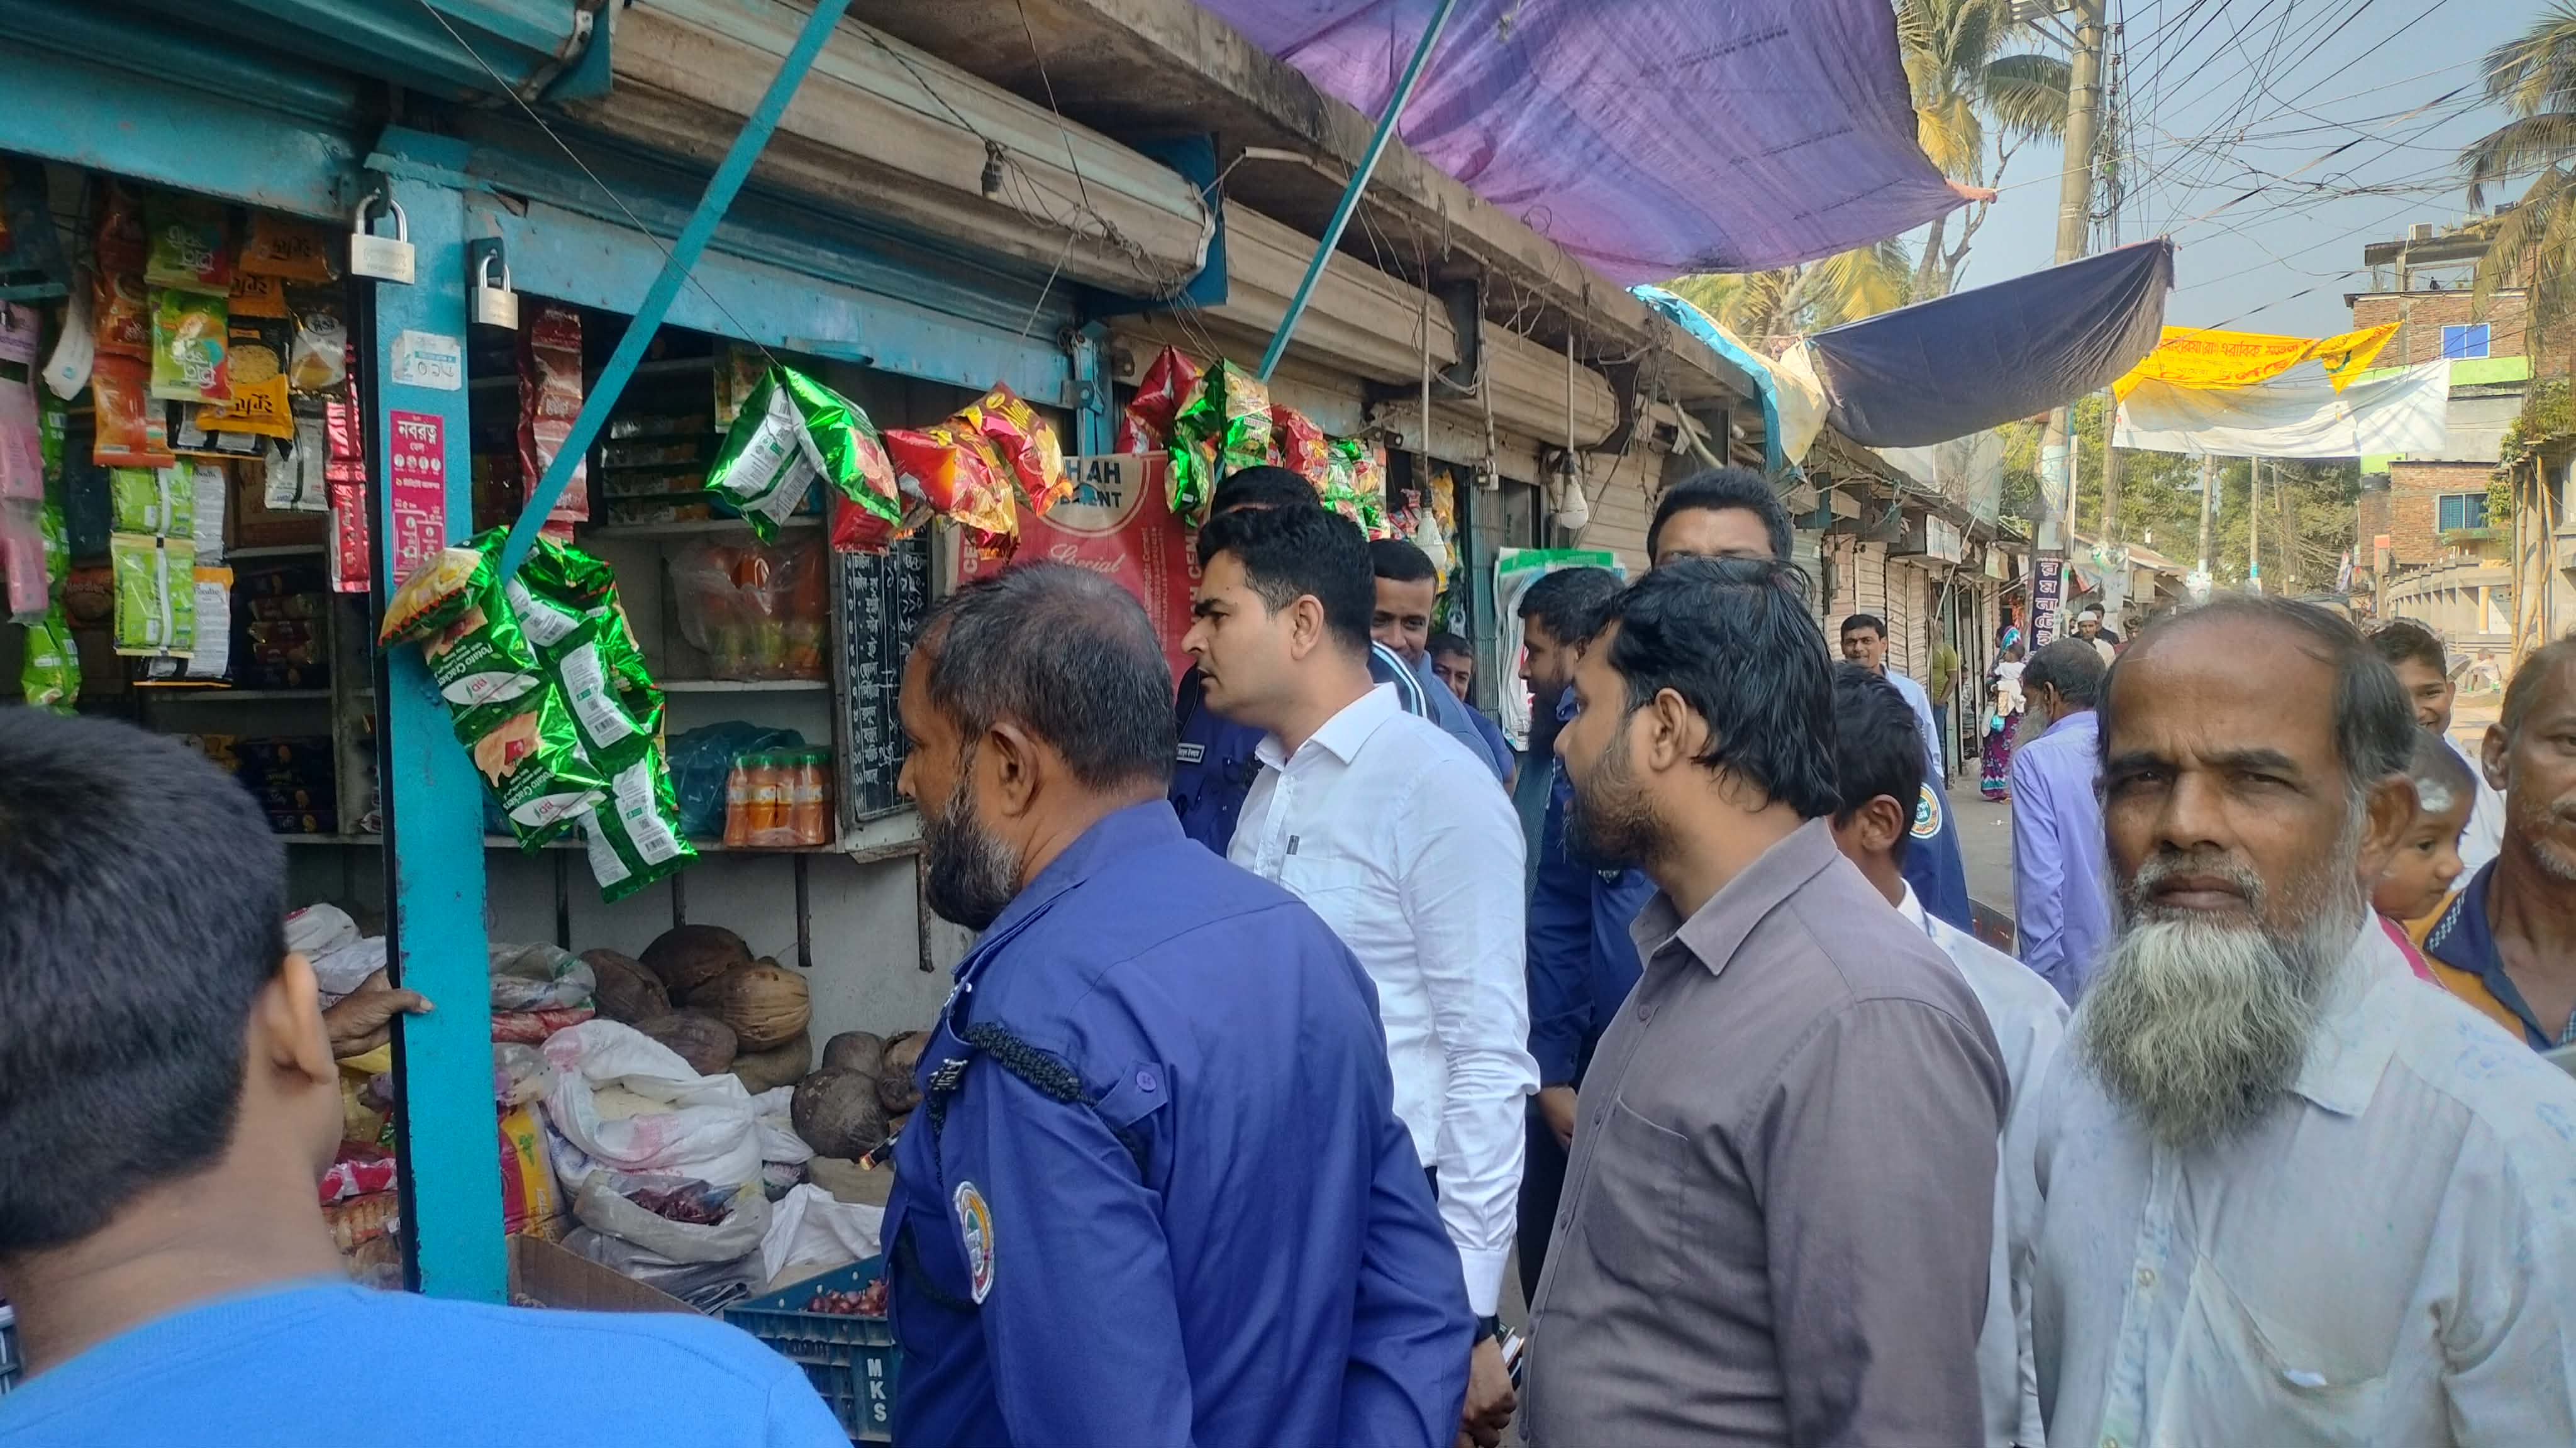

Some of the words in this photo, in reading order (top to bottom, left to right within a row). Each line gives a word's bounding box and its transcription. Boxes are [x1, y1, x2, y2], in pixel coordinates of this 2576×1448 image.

[397, 420, 437, 445] নবরত্ন
[1065, 460, 1121, 484] HAH
[465, 643, 494, 665] Potato
[438, 663, 467, 687] Cracker
[530, 768, 556, 788] Potato
[502, 785, 533, 810] Crackers
[867, 1357, 887, 1422] MKS
